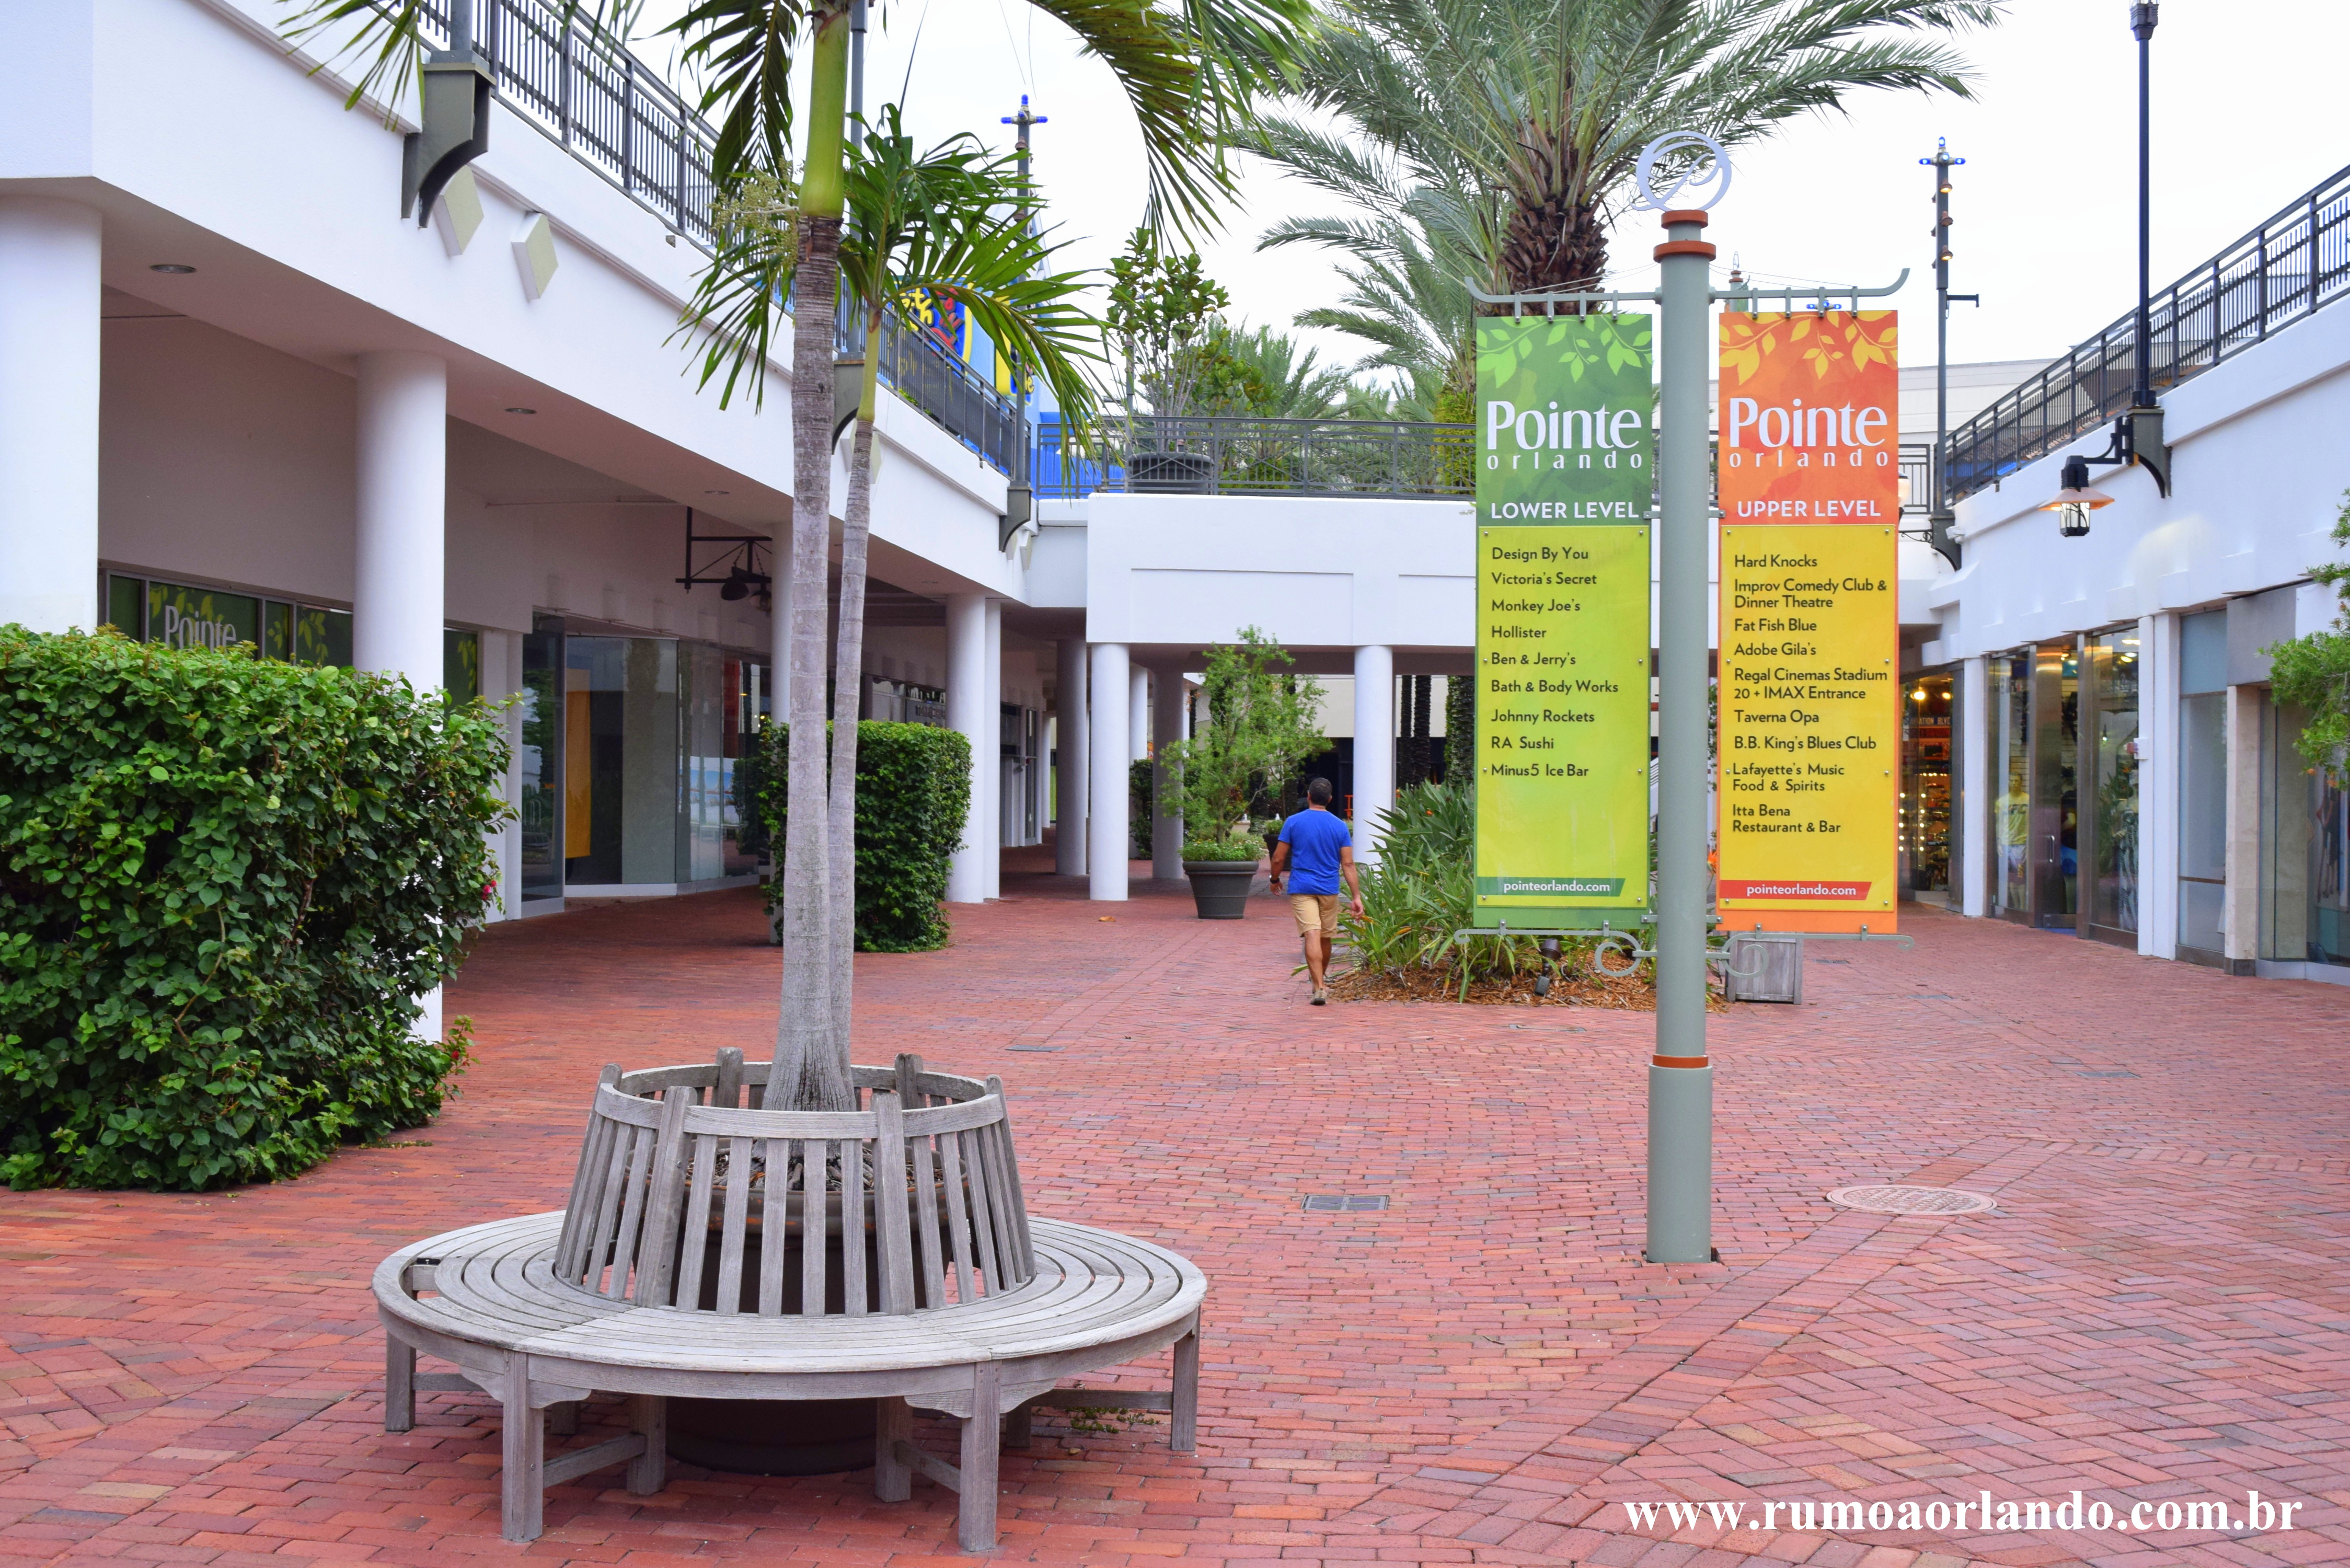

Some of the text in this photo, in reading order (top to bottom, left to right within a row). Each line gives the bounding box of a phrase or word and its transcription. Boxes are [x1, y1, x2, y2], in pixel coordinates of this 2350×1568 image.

[1487, 401, 1642, 449] Pointe
[1730, 398, 1887, 447] Pointe
[1487, 449, 1642, 469] orlando
[1730, 448, 1888, 467] orlando
[1491, 502, 1639, 518] LOWER LEVEL
[1738, 500, 1881, 517] UPPER LEVEL
[1492, 547, 1588, 562] Design By You
[1735, 554, 1817, 567] Hard Knocks
[1491, 572, 1597, 584] Victoria's Secret
[1735, 578, 1886, 594] Improv Comedy Club &
[1492, 599, 1580, 614] Monkey Joe's
[1735, 595, 1833, 608] Dinner Theatre
[165, 605, 236, 654] Pointe
[1735, 618, 1817, 631] Fat Fish Blue
[1492, 626, 1547, 638] Hollister
[1734, 642, 1816, 655] Adobe Gila's
[1492, 652, 1576, 667] Ben & Jerry's
[1735, 668, 1887, 684] Regal Cinemas Stadium
[1492, 680, 1618, 695] Bath & Body Works
[1734, 688, 1750, 699] 20
[1765, 686, 1805, 699] IMAX
[1809, 686, 1865, 699] Entrance
[1491, 710, 1594, 724] Johnny Rockets
[1734, 710, 1819, 725] Taverna Opa
[1492, 736, 1554, 749] RA Sushi
[1735, 736, 1876, 752] B.B. King's Blues Club
[1492, 764, 1588, 776] Minus5 Ice Bar
[1733, 763, 1844, 777] Lafayette's Music
[1733, 779, 1825, 793] Food & Spirits
[1733, 804, 1790, 816] Itta Bena
[1733, 820, 1841, 833] Restaurant & Bar
[1503, 880, 1610, 894] pointeorlando.com
[1746, 883, 1856, 897] pointeorlando.com
